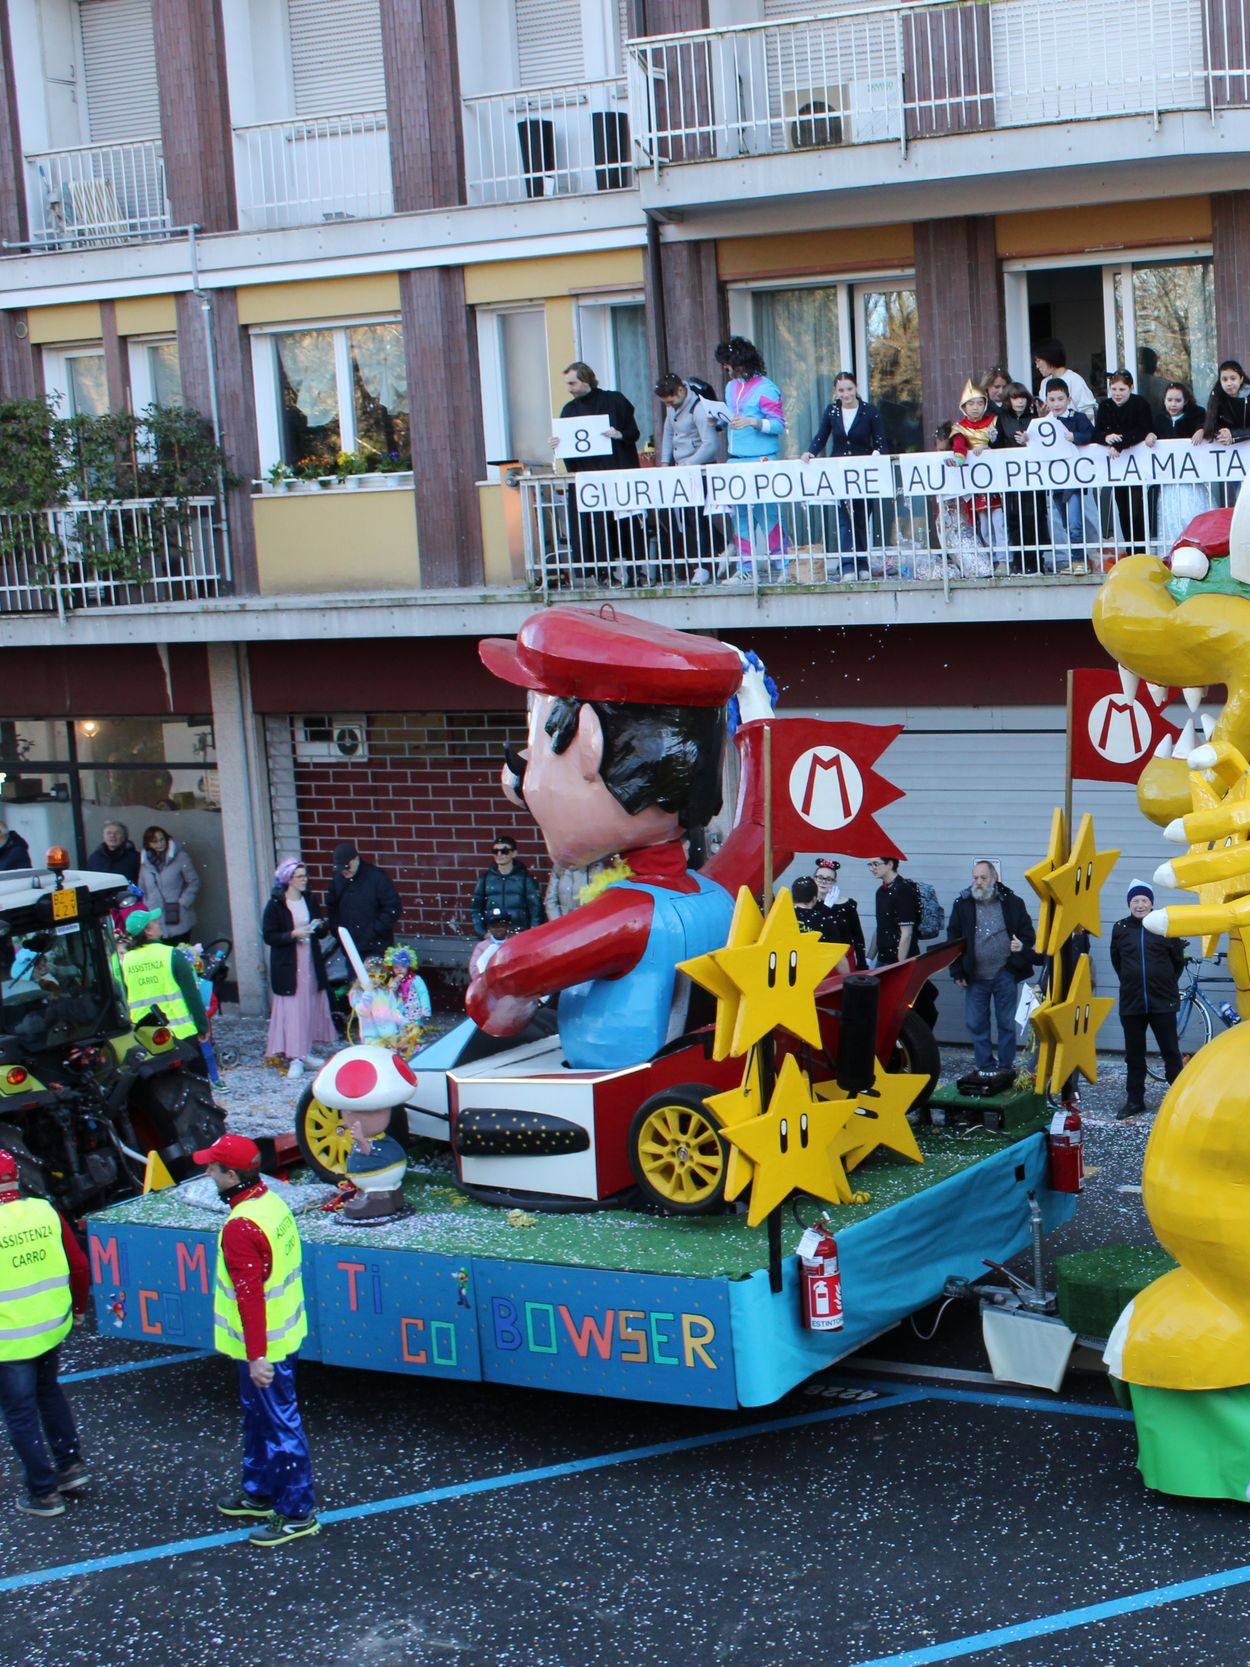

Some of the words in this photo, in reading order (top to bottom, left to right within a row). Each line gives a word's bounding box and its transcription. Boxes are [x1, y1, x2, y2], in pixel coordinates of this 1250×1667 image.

[574, 428, 593, 453] 8
[1037, 421, 1058, 448] 9
[579, 477, 690, 508] GIURIA
[711, 468, 880, 500] POPOLARE
[1098, 698, 1143, 755] M
[801, 752, 853, 820] M
[137, 976, 160, 987] CARRO
[12, 1249, 47, 1268] CARRO
[490, 1295, 719, 1370] BOWSER
[811, 1318, 843, 1328] ESTINTO
